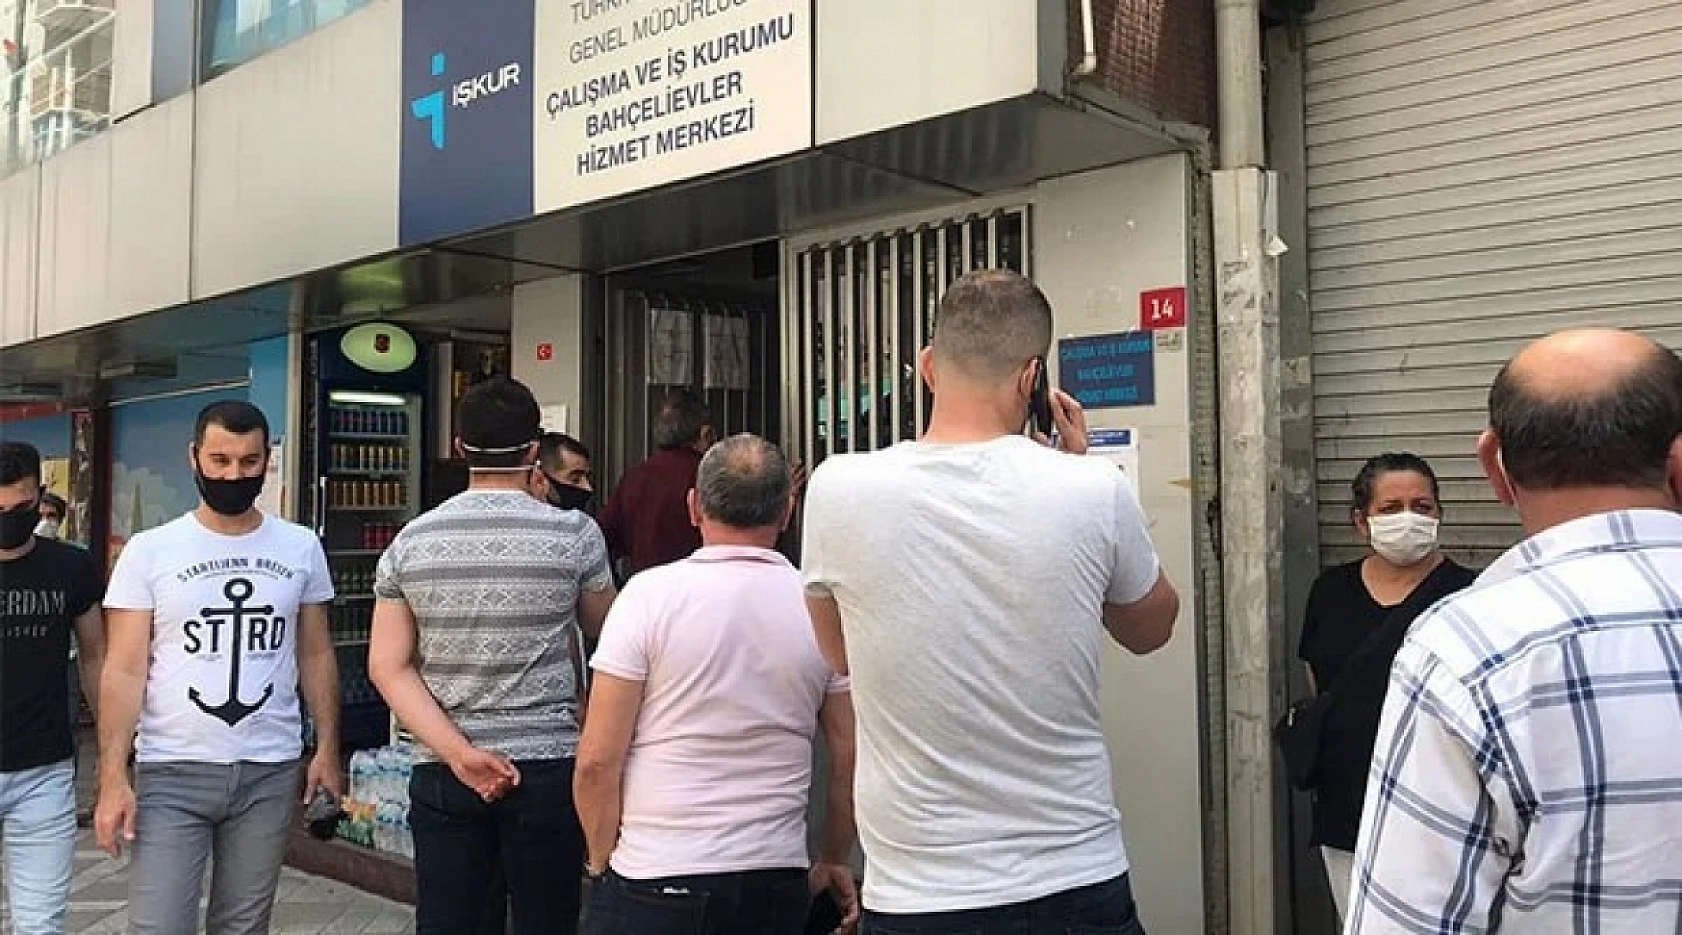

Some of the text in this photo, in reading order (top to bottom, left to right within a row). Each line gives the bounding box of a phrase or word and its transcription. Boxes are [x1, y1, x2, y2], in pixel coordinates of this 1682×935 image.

[546, 13, 794, 119] ÇALIŞMA VE İŞ KURUMU
[569, 26, 628, 64] GENEL
[577, 98, 756, 176] HİZMET MERKEZİ
[586, 70, 743, 138] BAHÇELİEVLER
[1151, 298, 1173, 320] 14
